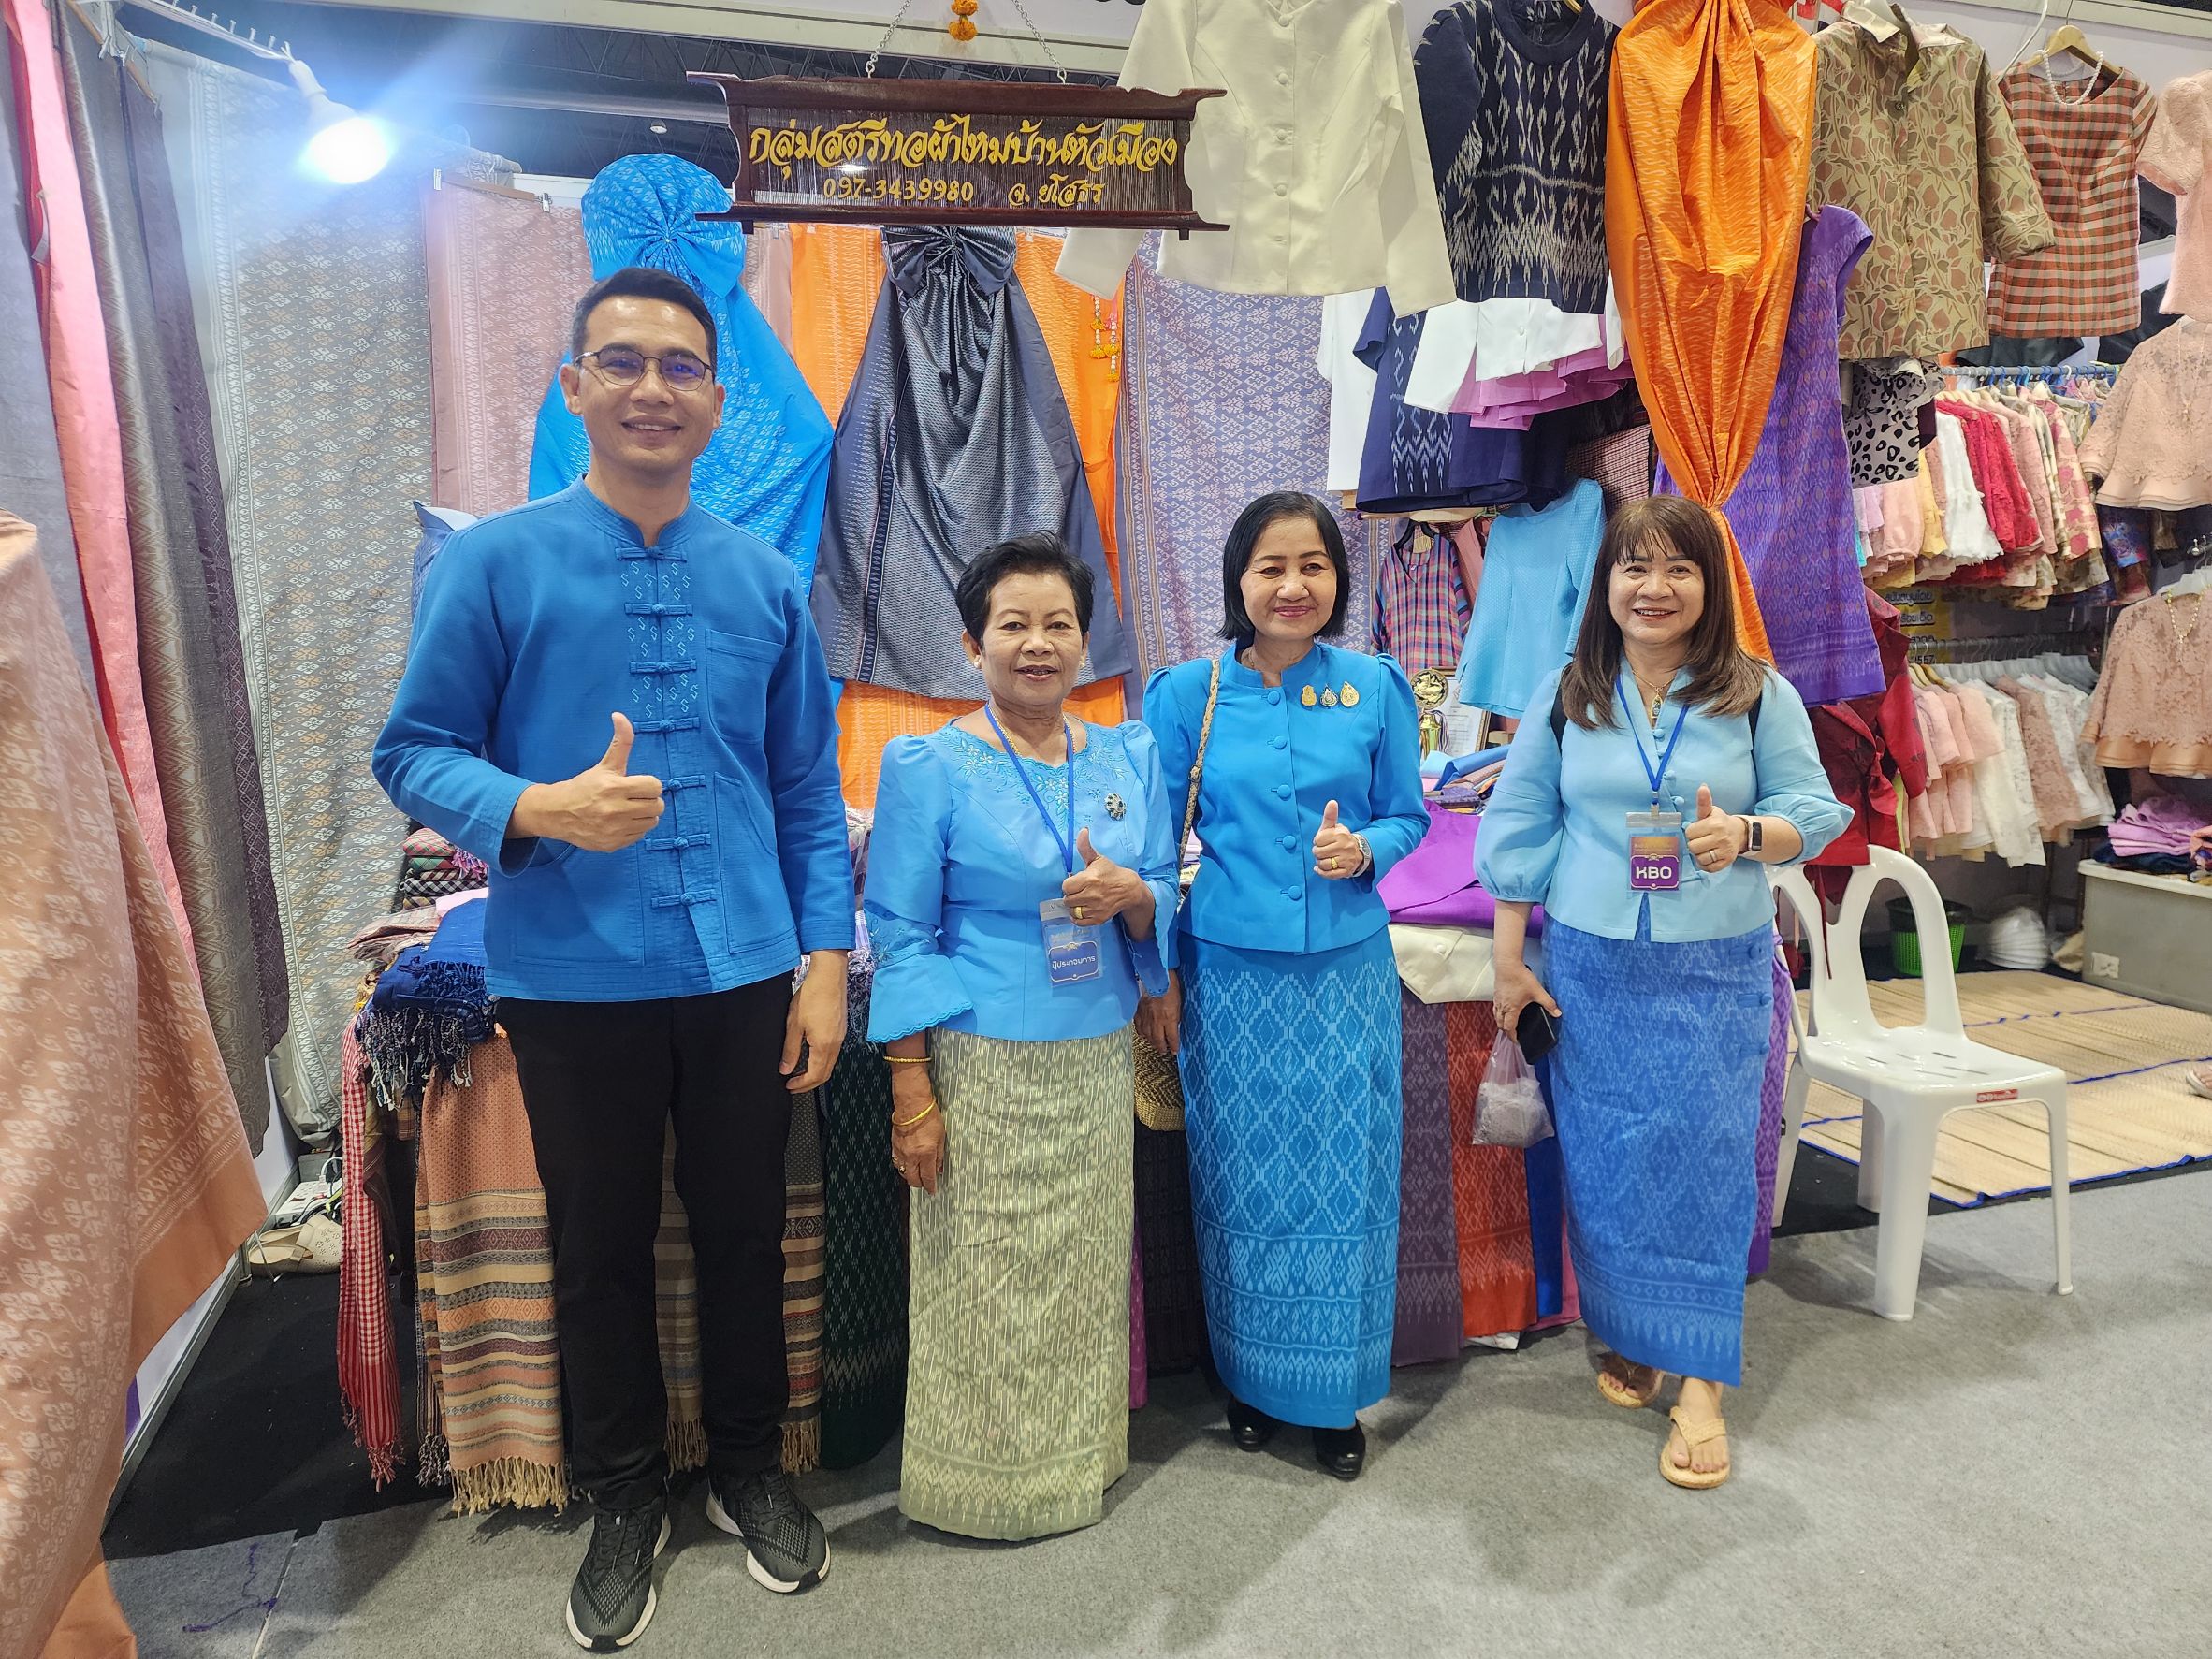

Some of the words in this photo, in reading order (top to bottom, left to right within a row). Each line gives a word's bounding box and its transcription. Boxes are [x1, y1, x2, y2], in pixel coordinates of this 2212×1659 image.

[749, 113, 1178, 181] กลุ่มสตรีทอผ้าไหมบ้านหัวเมือง
[823, 177, 974, 202] 097-3439980
[1008, 183, 1030, 207] จ.
[1039, 173, 1106, 208] ยโสธร
[1636, 866, 1672, 880] KBO
